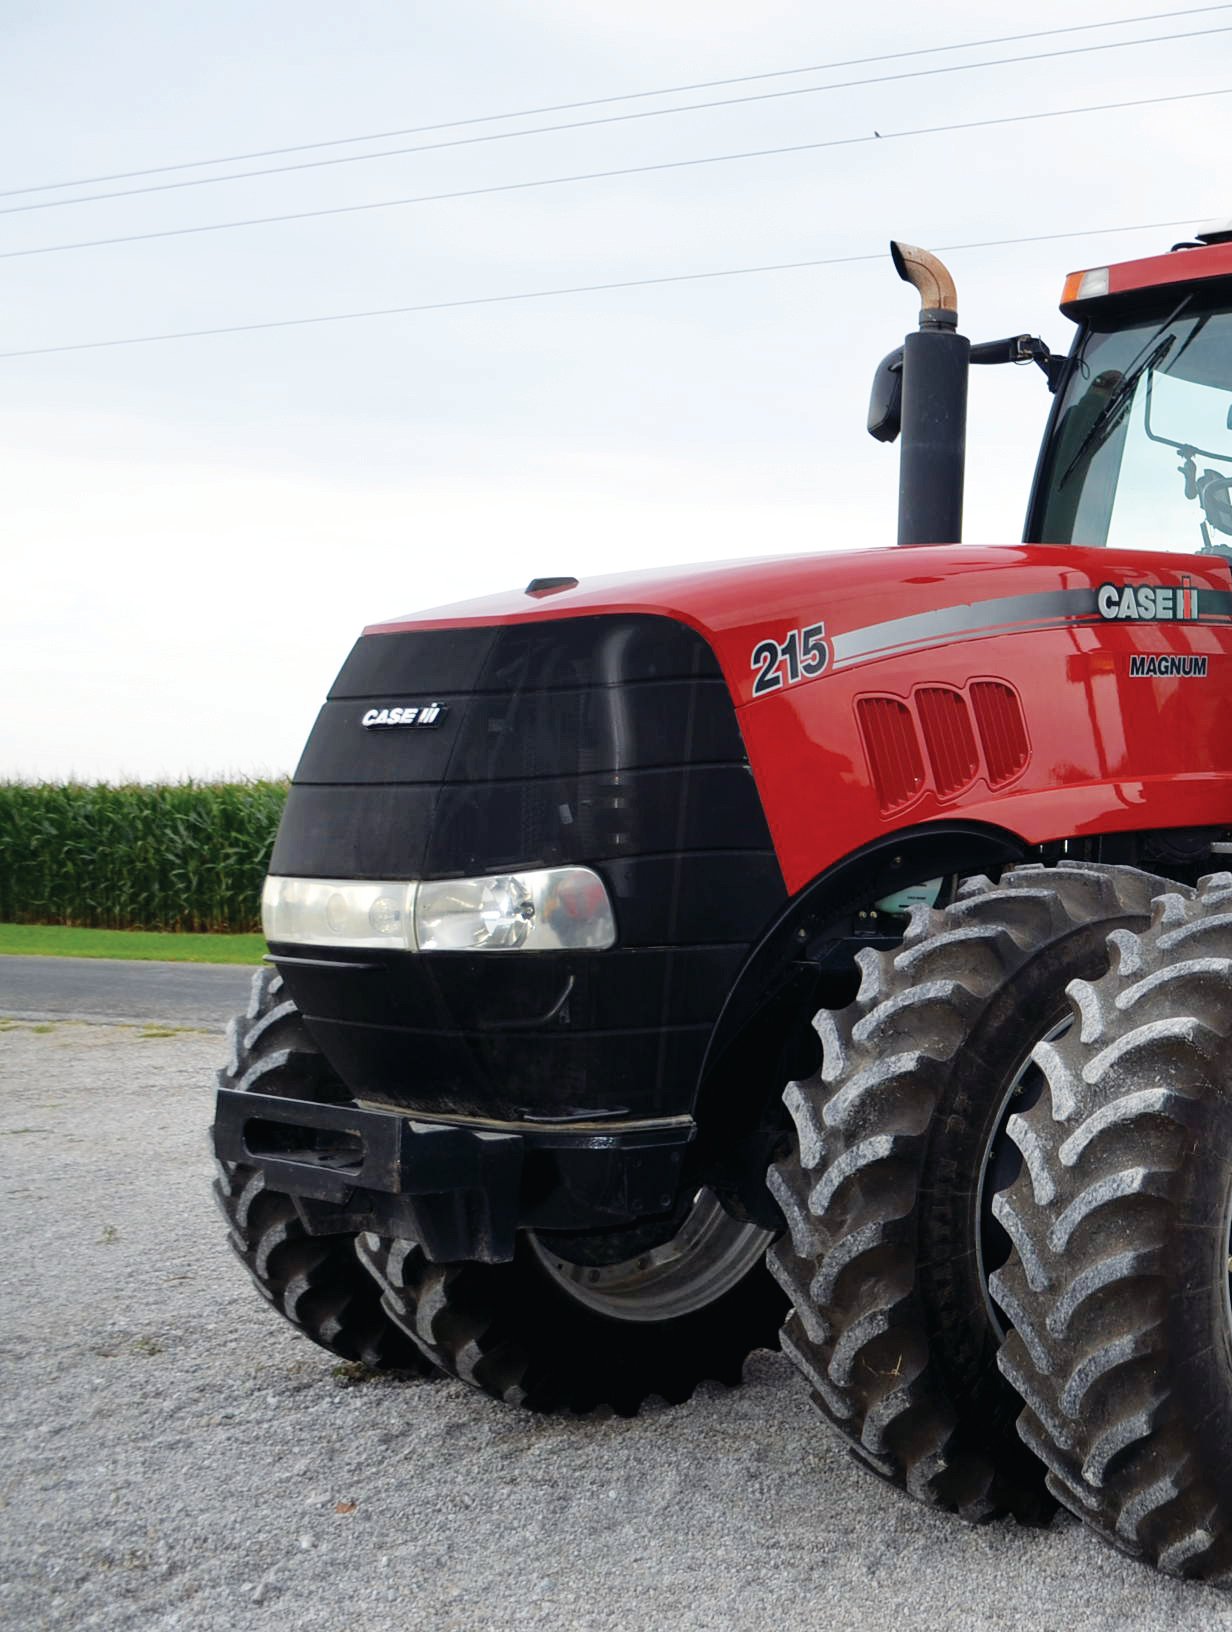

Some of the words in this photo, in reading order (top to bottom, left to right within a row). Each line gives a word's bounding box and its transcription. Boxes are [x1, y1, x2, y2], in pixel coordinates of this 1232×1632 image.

[1097, 584, 1174, 620] CASE
[751, 621, 829, 698] 215
[1129, 655, 1208, 678] MAGNUM
[362, 707, 419, 726] CASE
